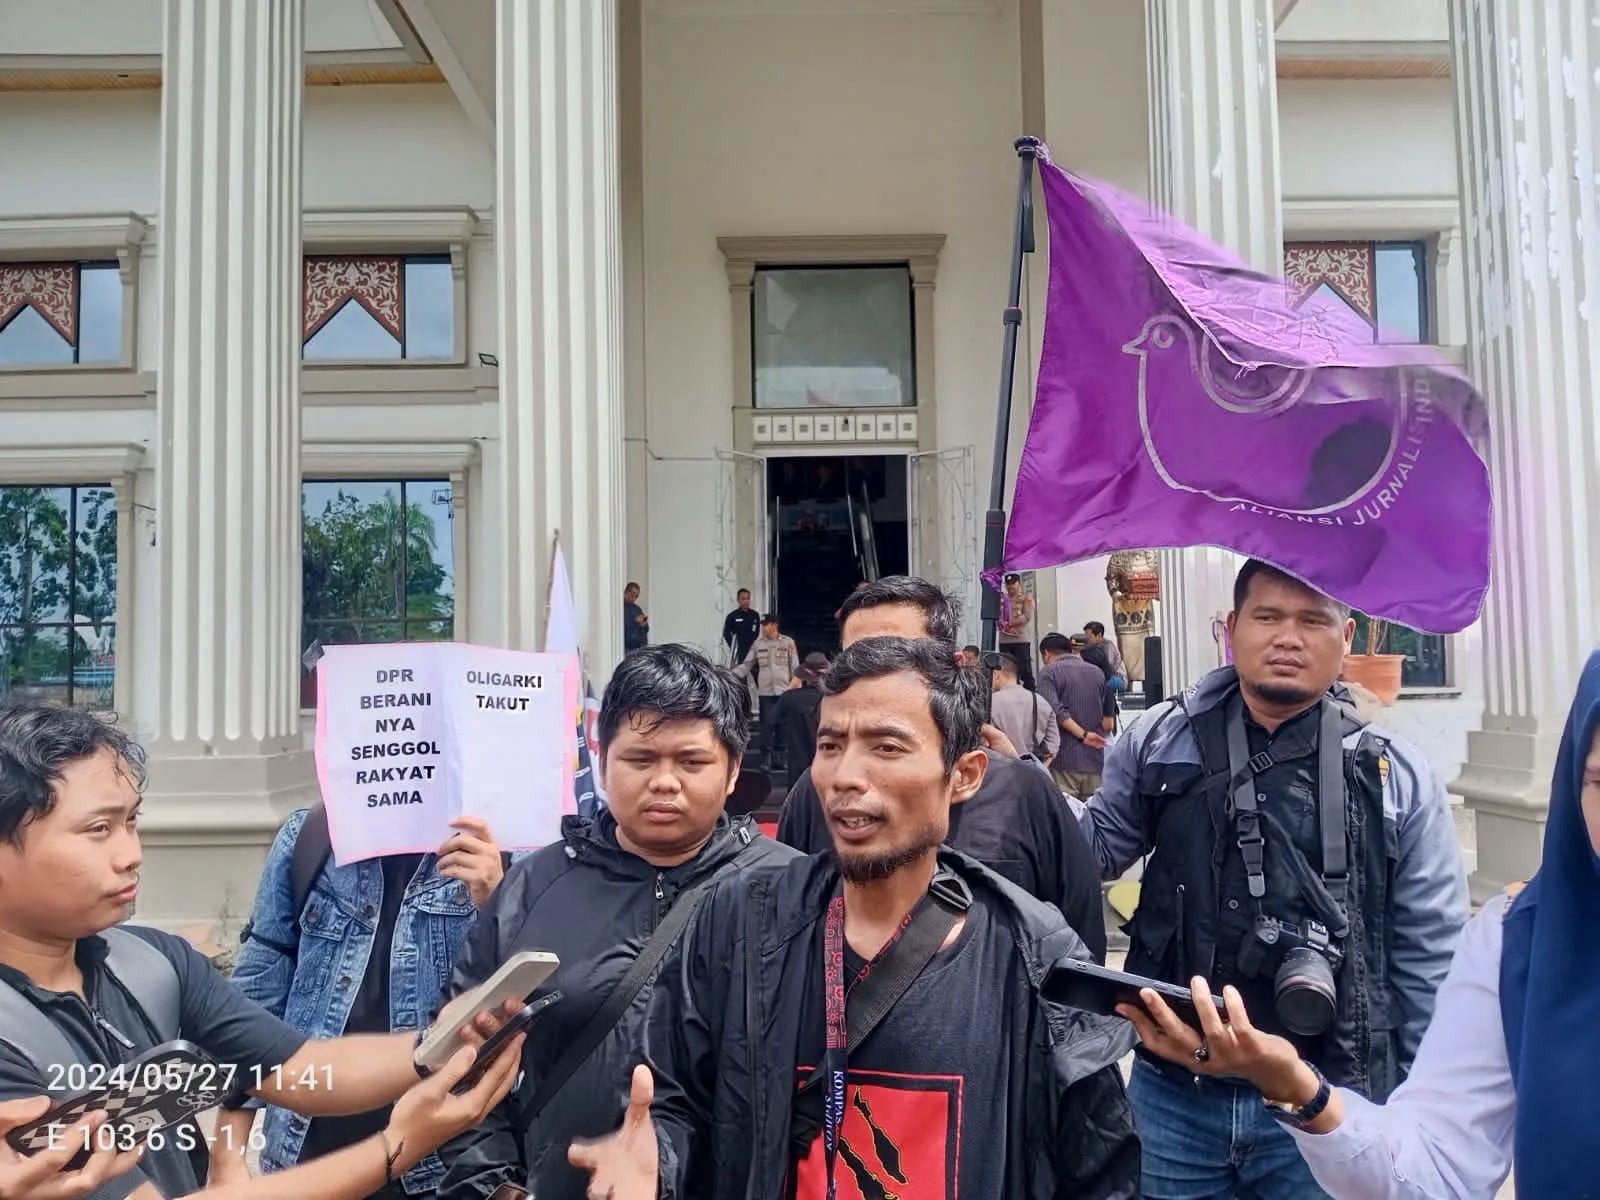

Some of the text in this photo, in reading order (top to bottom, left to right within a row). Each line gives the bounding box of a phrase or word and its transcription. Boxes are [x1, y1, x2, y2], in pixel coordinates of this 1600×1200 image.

[1229, 503, 1343, 526] ALIANSI
[1413, 378, 1433, 422] IND
[376, 669, 414, 684] DPR
[466, 670, 542, 689] OLIGARKI
[360, 693, 431, 709] BERANI
[476, 695, 530, 711] TAKUT
[375, 718, 415, 733] NYA
[351, 741, 441, 760] SENGGOL
[356, 765, 436, 784] RAKYAT
[367, 790, 423, 807] SAMA
